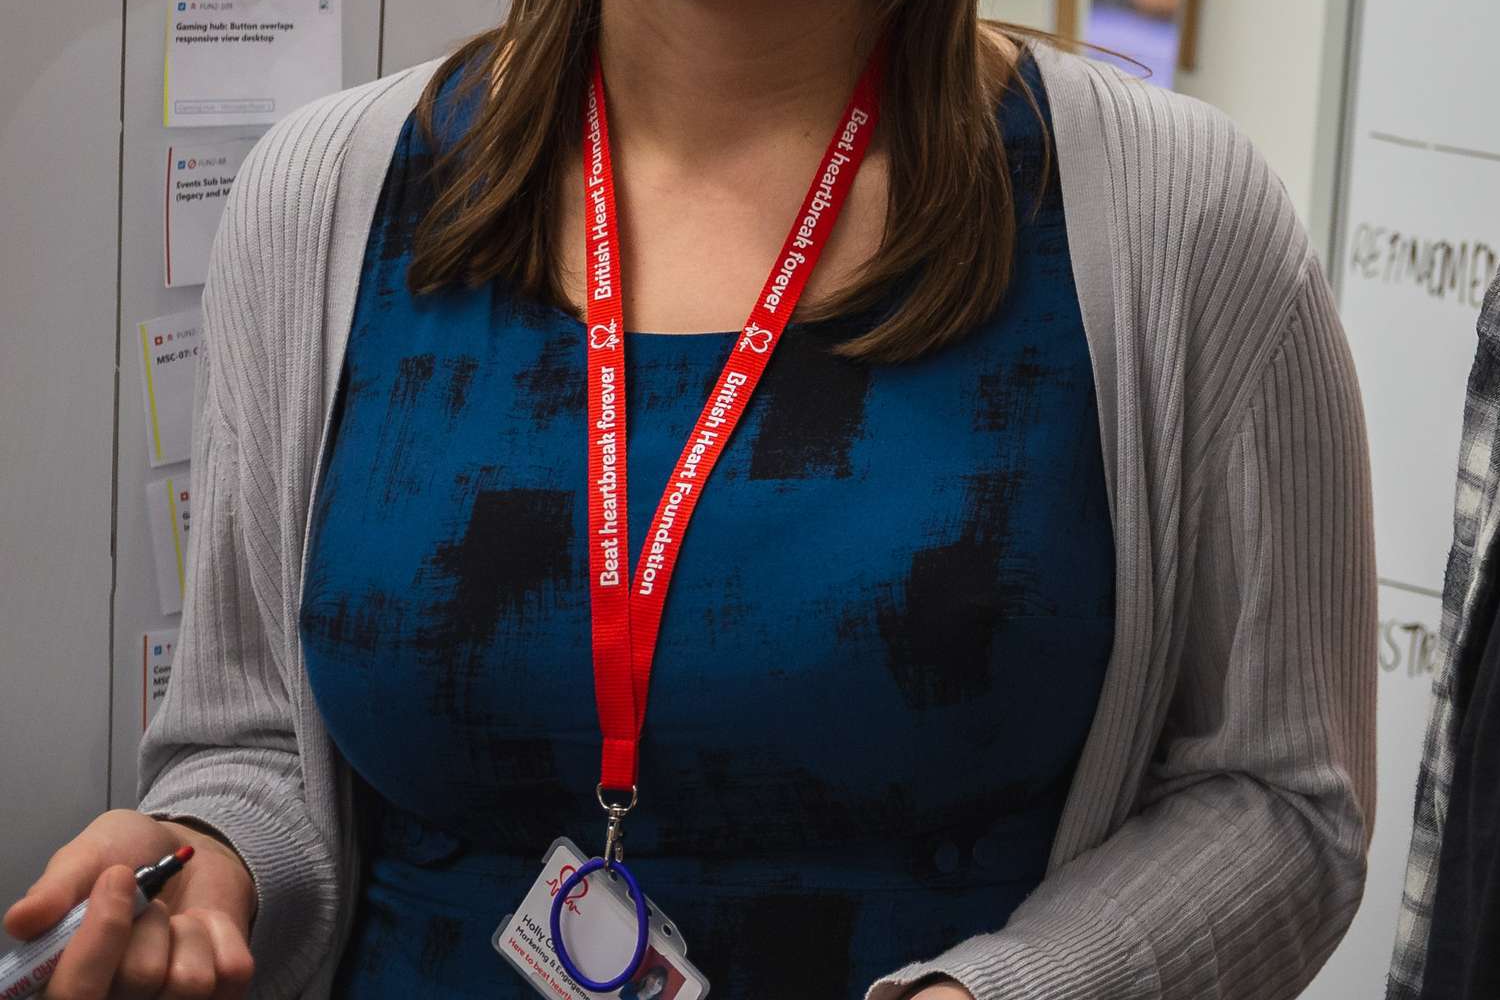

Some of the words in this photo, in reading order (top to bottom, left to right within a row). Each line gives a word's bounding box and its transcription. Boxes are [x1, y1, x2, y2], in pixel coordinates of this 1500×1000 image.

[176, 22, 208, 33] Gaming
[229, 22, 258, 31] Button
[259, 22, 294, 32] overlaps
[176, 35, 219, 44] responsive
[241, 34, 274, 44] desktop
[837, 107, 869, 152] Beat
[205, 189, 220, 198] and
[591, 186, 609, 241] Heart
[792, 151, 850, 249] heartbreak
[594, 240, 612, 300] British
[763, 250, 806, 314] forever
[597, 366, 616, 429] forever
[705, 370, 747, 427] British
[679, 429, 719, 479] Heart
[597, 431, 617, 536] heartbreak
[600, 537, 620, 586] Beat
[639, 481, 693, 596] Foundation
[515, 926, 549, 963] Marketing
[522, 914, 546, 942] Holly
[508, 937, 526, 958] Here
[525, 952, 534, 965] to
[533, 962, 550, 981] beat
